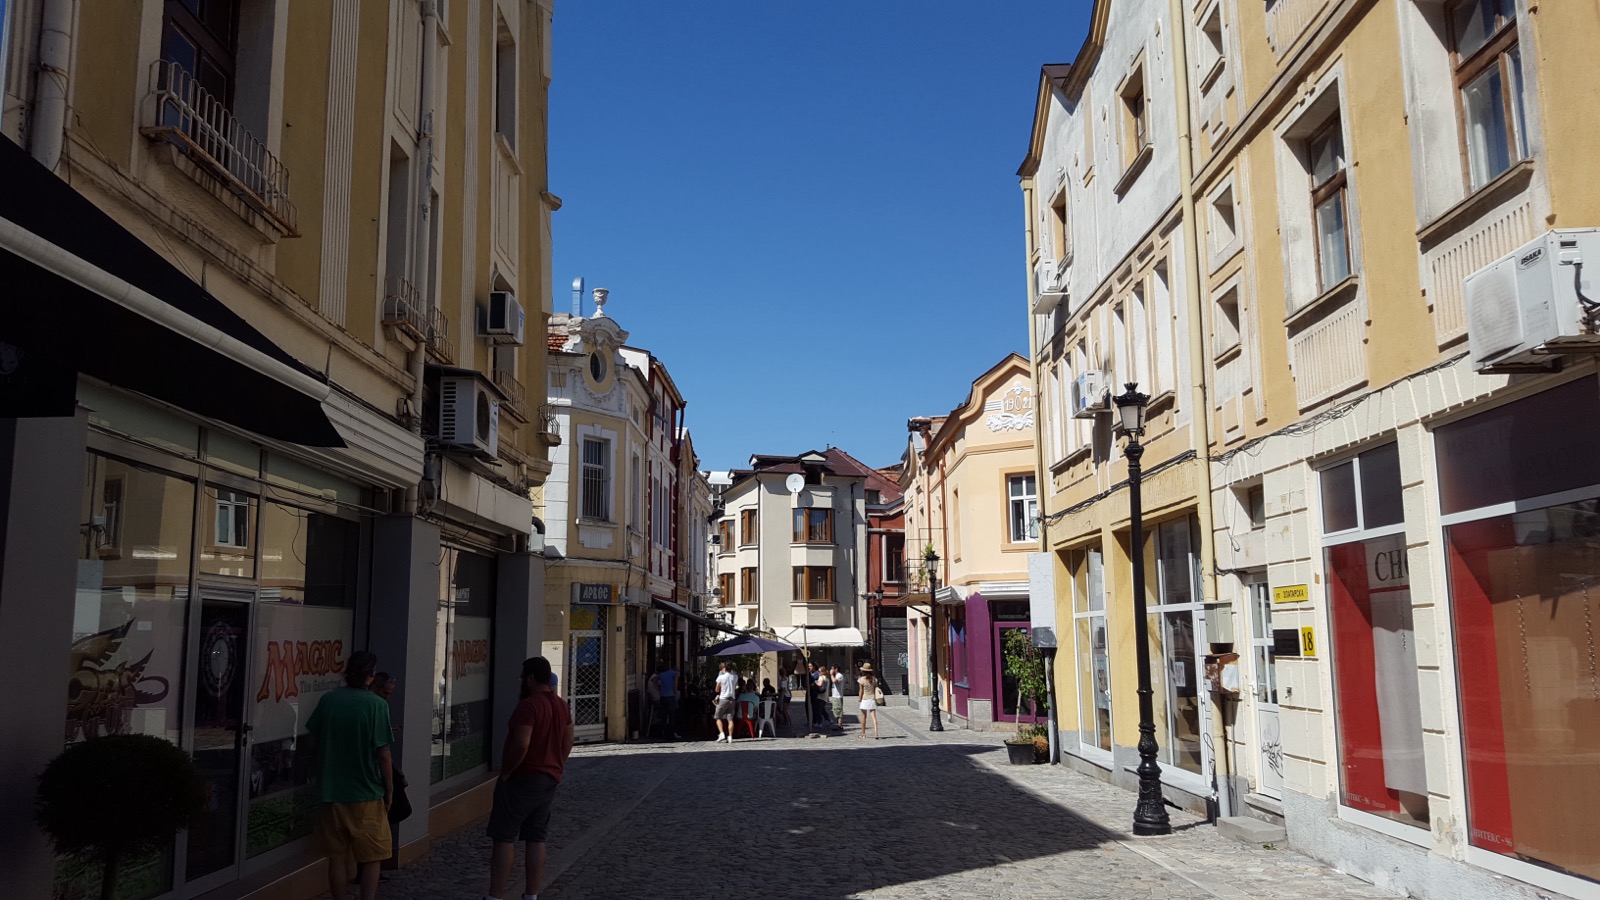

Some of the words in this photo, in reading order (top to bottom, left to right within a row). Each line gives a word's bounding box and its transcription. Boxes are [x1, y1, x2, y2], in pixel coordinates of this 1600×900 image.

[1520, 248, 1542, 265] OSAKA
[1302, 631, 1314, 652] 18
[1472, 827, 1500, 844] НИТЕКС
